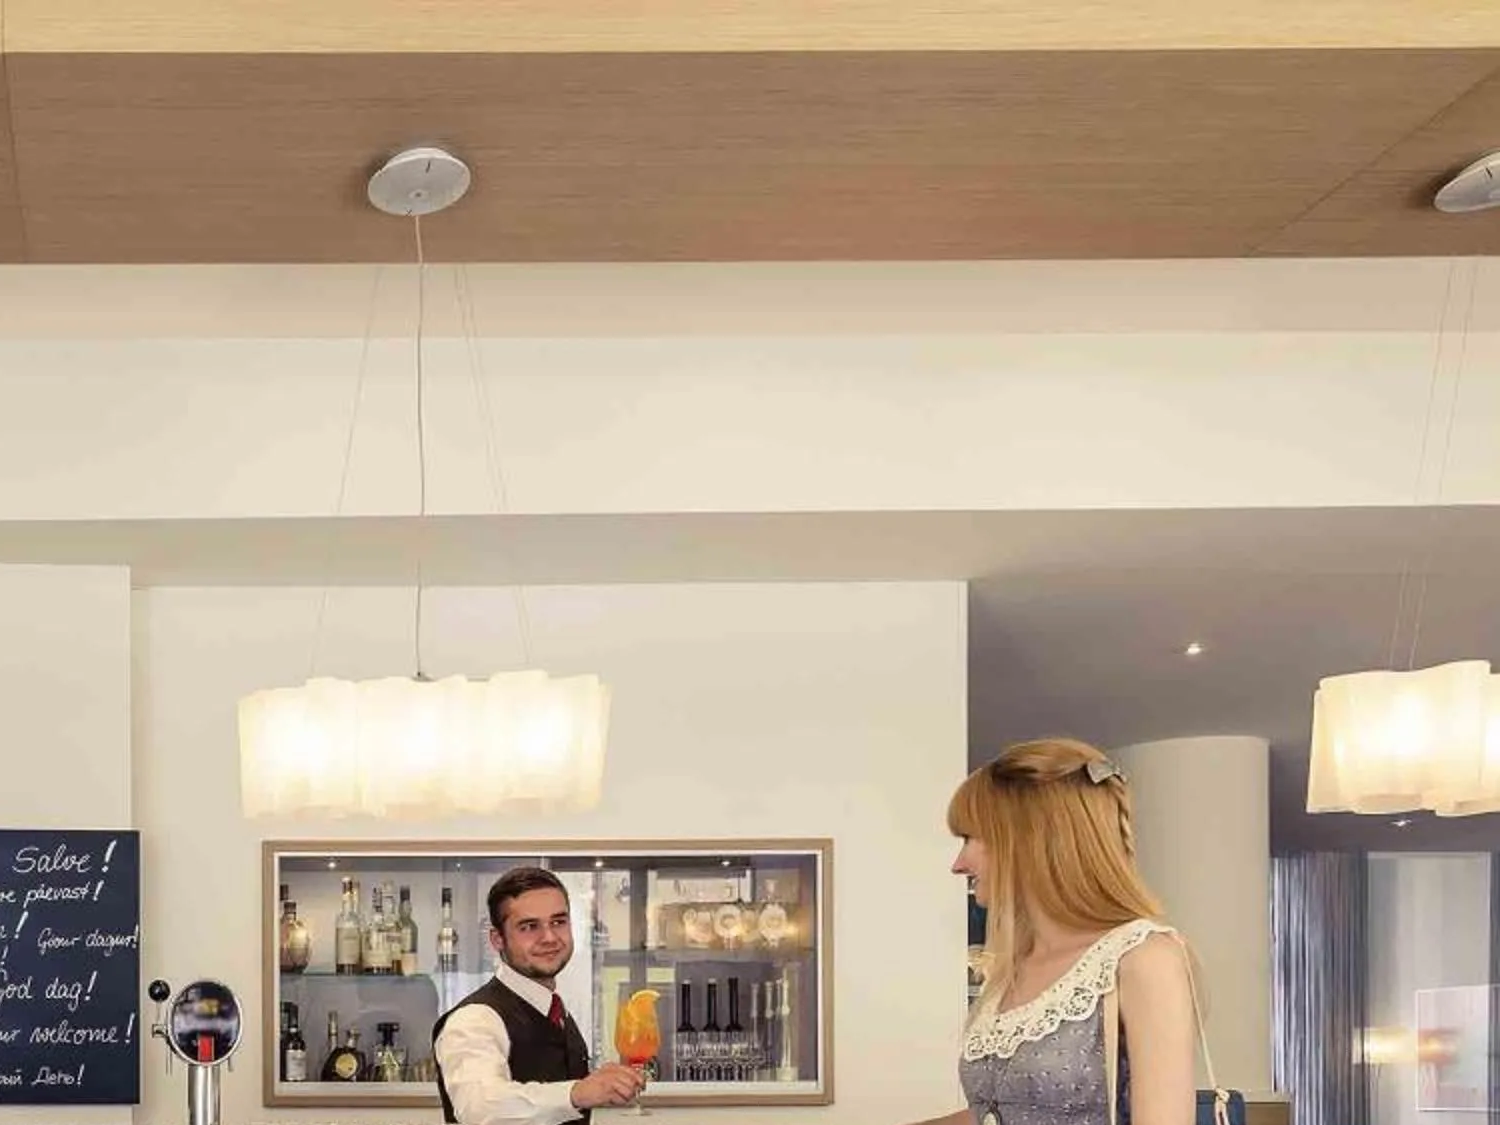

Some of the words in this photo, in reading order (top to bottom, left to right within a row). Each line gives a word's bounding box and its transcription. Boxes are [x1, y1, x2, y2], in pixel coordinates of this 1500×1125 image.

[12, 840, 117, 873] Salve!
[45, 971, 97, 1012] dag!
[29, 1012, 136, 1044] welcome!
